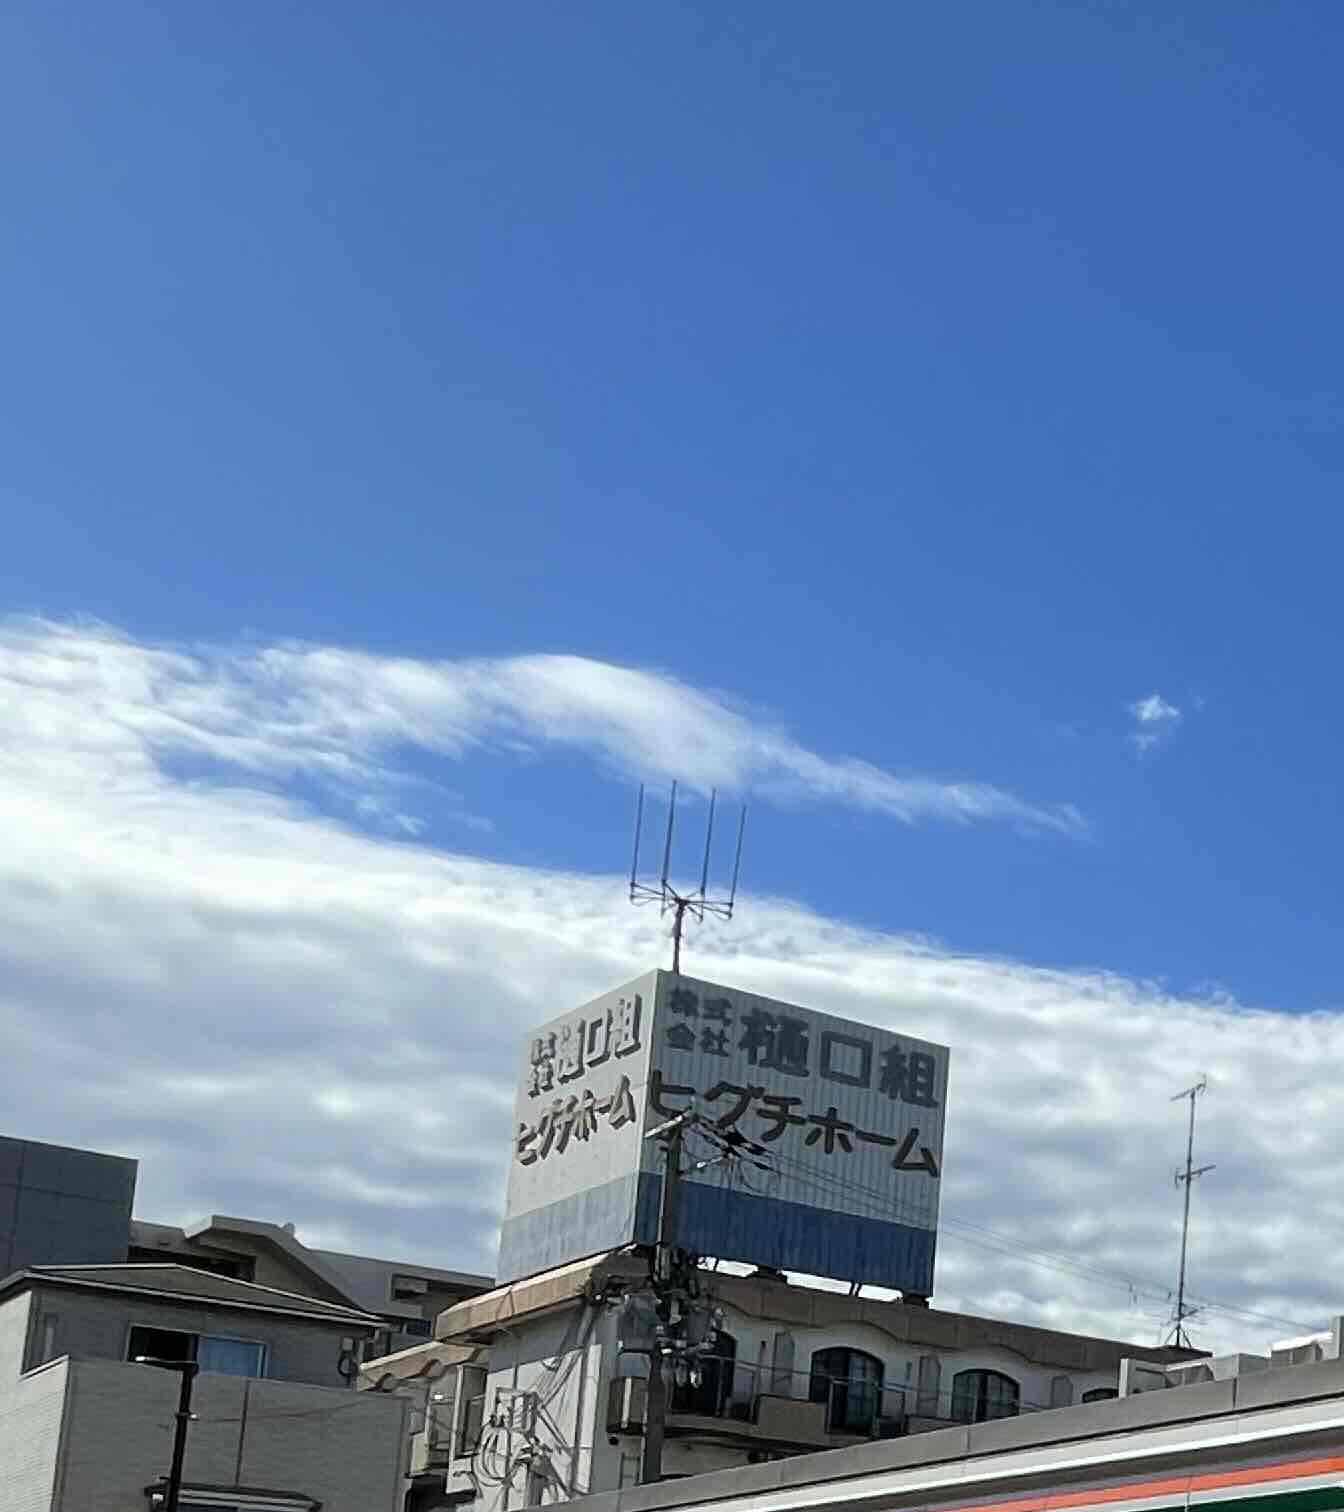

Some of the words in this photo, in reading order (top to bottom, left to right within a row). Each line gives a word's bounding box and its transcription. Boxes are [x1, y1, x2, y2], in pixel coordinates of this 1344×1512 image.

[740, 1007, 939, 1109] 樋口組
[515, 1074, 637, 1166] ヒグチホーム
[649, 1070, 940, 1178] ヒグチホーム
